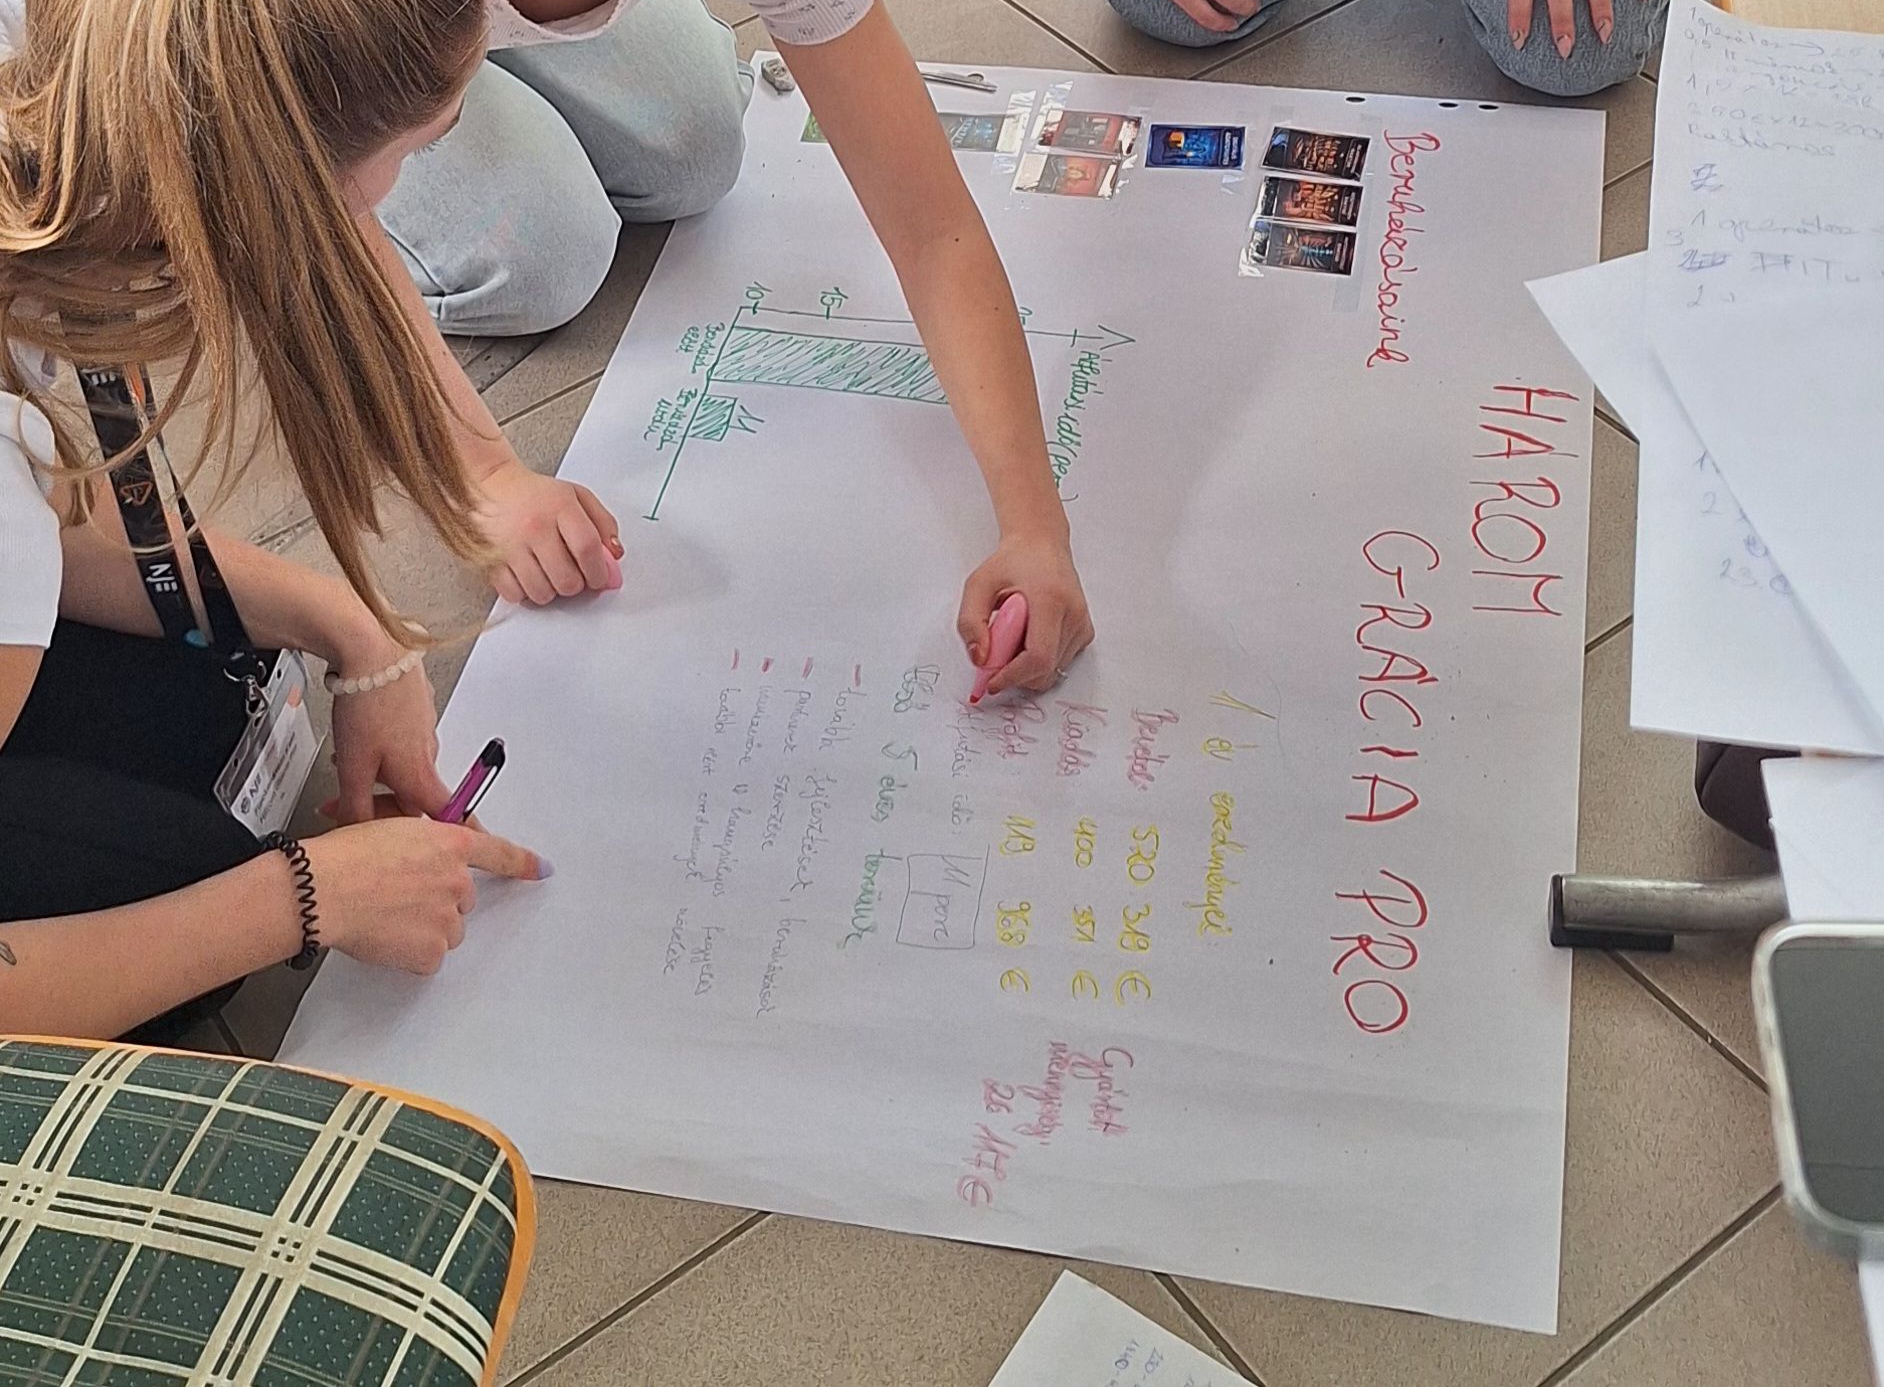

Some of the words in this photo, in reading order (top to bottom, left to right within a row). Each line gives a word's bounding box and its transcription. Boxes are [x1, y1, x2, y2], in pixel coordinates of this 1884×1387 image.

[1345, 530, 1440, 823] GRÁCIA
[1075, 817, 1099, 868] 400
[1126, 825, 1159, 885] 520
[1119, 904, 1152, 952] 319
[1330, 869, 1429, 1034] PRO
